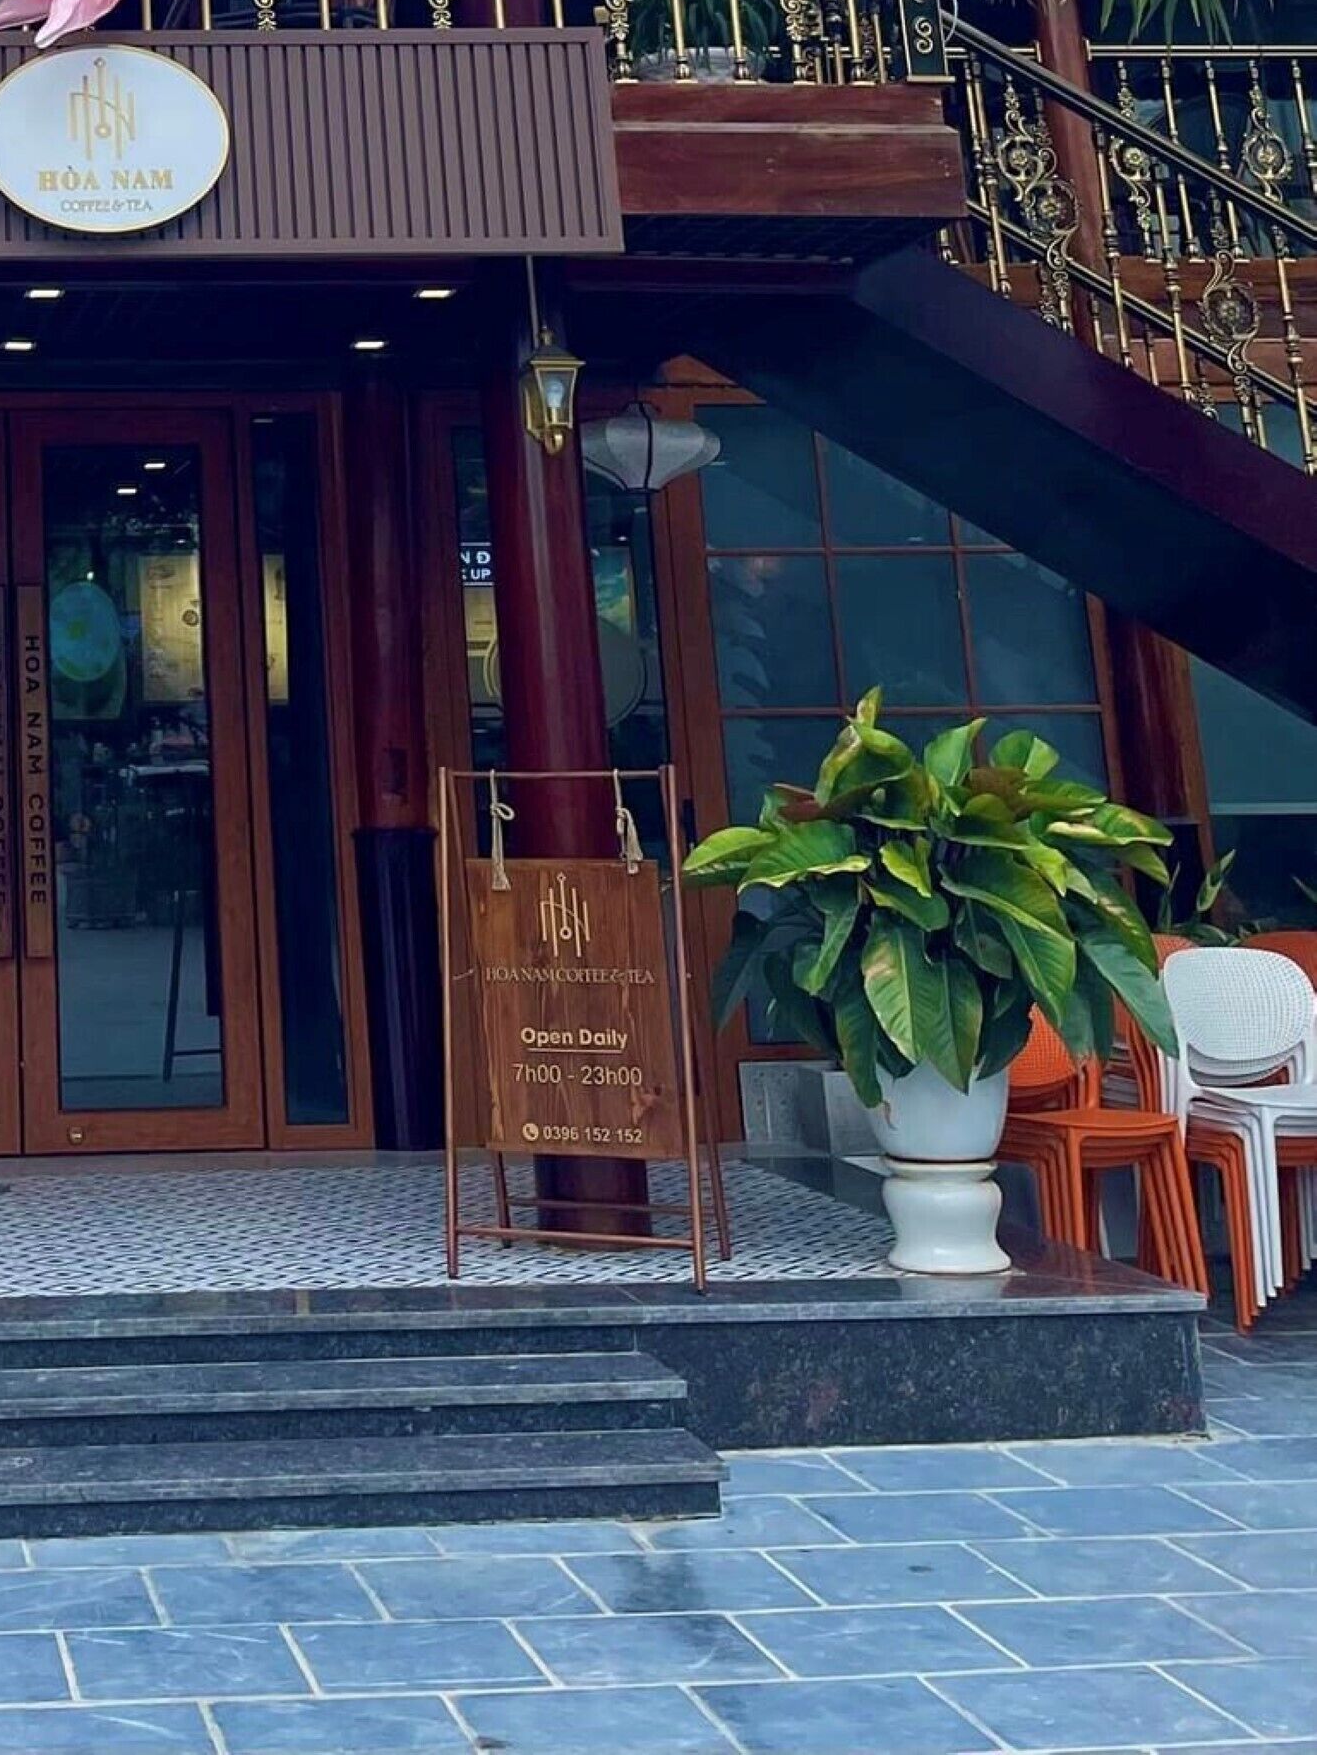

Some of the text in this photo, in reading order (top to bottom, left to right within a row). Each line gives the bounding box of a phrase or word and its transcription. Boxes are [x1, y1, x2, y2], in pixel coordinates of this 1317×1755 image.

[38, 165, 174, 192] HÒA NAM
[27, 711, 43, 775] NAM
[30, 794, 47, 904] COFFEE
[521, 1027, 628, 1049] Open Daily
[512, 1063, 561, 1084] 7h00
[580, 1065, 642, 1086] 23h00
[584, 1127, 611, 1142] 152
[615, 1128, 642, 1144] 152
